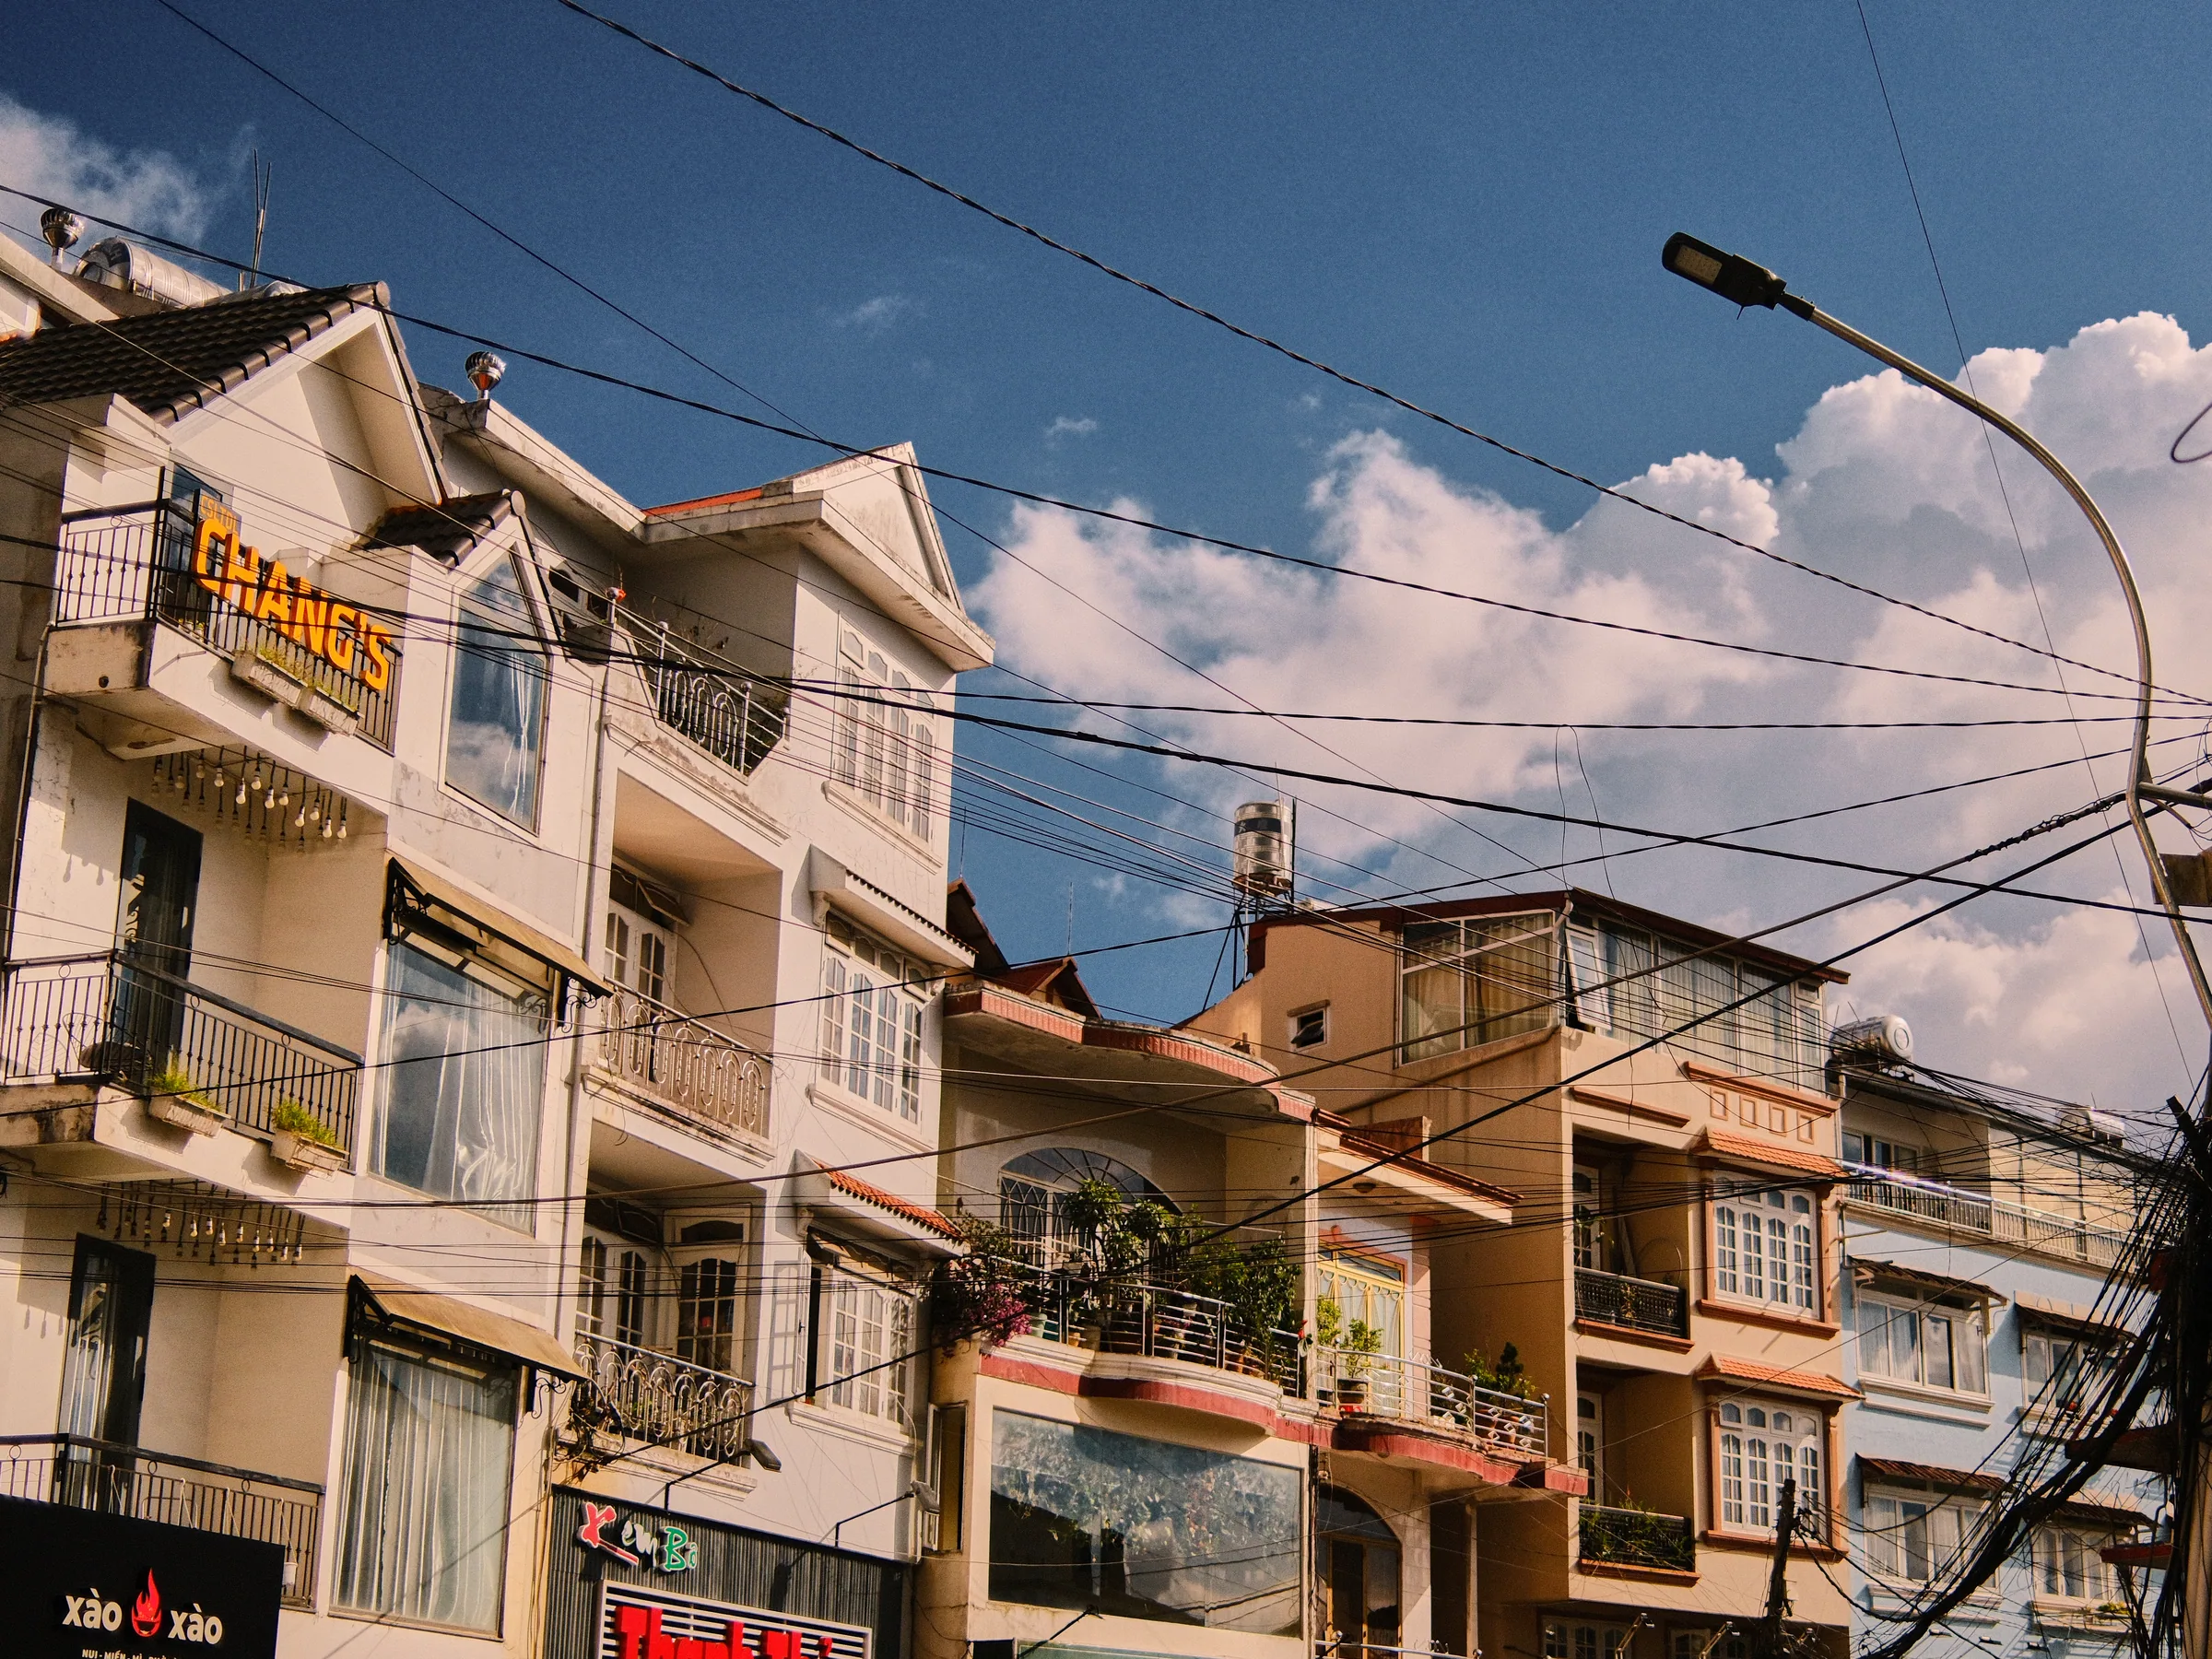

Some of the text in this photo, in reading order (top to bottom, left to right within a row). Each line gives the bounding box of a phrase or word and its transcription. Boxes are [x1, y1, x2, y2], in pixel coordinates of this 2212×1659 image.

[192, 518, 392, 691] CHANG'S
[63, 1587, 223, 1645] xào xào
[82, 1649, 98, 1659] NUI
